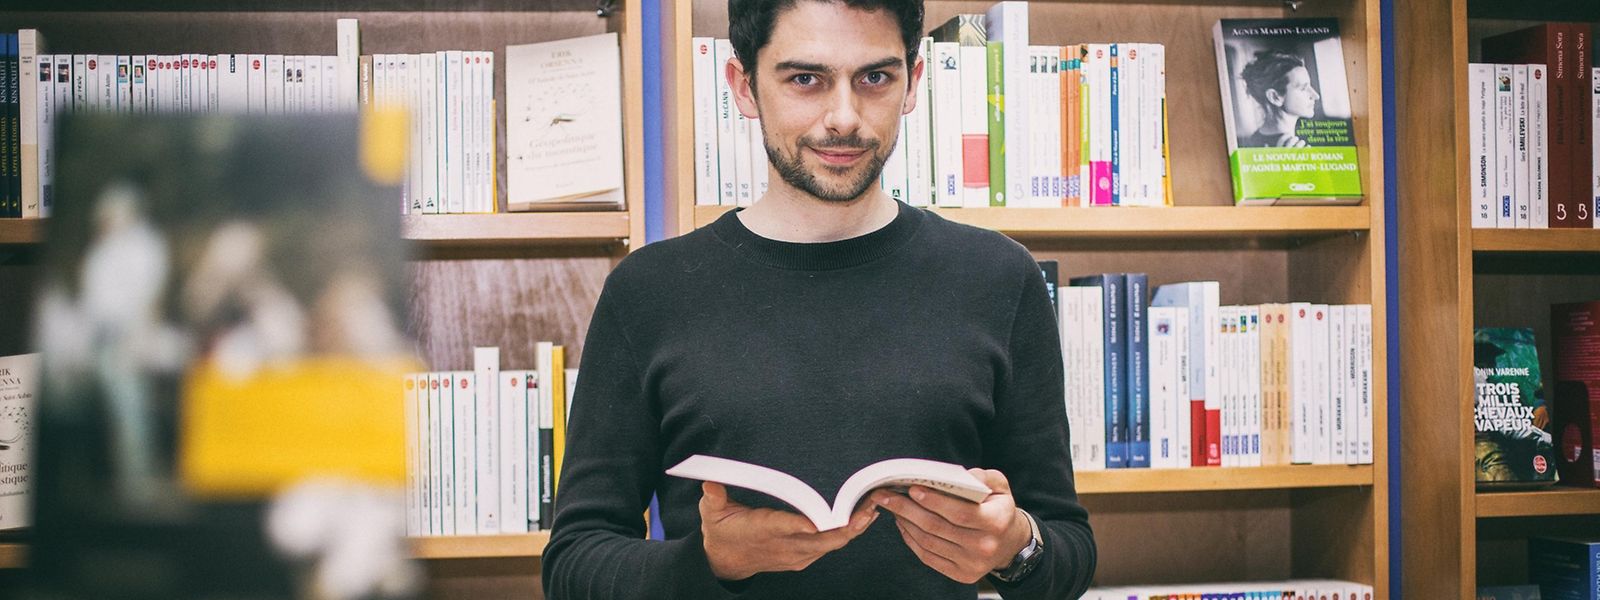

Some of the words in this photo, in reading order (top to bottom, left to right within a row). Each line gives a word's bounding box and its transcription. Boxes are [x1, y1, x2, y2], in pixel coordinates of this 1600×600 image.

[1555, 32, 1564, 49] Sora
[1576, 32, 1584, 50] Sora
[1556, 50, 1564, 79] Simona
[1576, 50, 1584, 79] Simona
[1300, 120, 1313, 128] J'ai
[1314, 120, 1347, 130] toujours
[1316, 128, 1348, 138] musique
[1253, 153, 1265, 162] LE
[1266, 153, 1309, 162] NOUVEAU
[1311, 152, 1343, 161] ROMAN
[1496, 368, 1530, 376] VARENNE
[1477, 383, 1520, 395] TROIS
[1478, 395, 1521, 407] MILLE
[1474, 419, 1532, 432] VAPEUR
